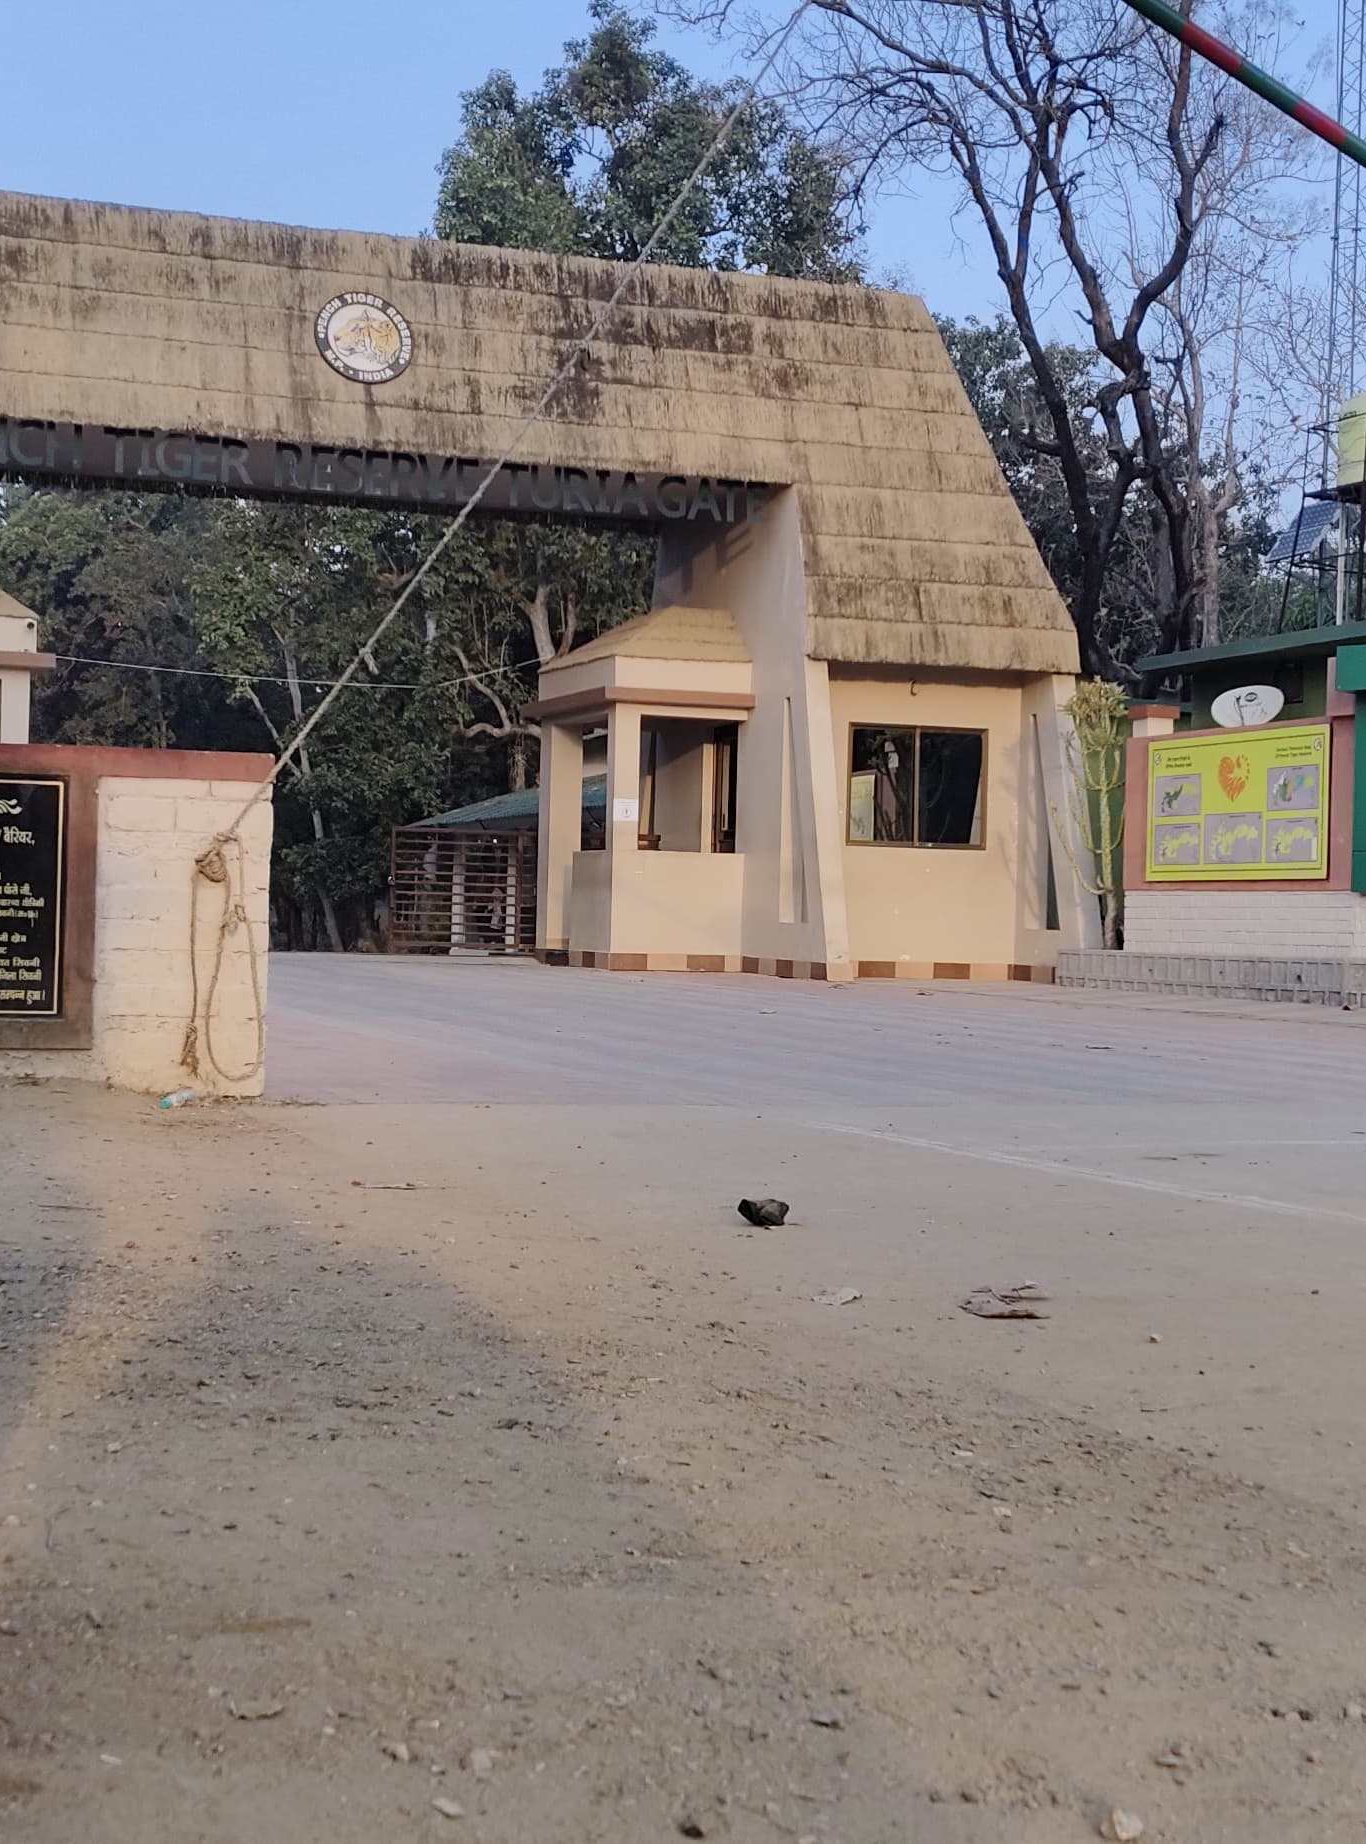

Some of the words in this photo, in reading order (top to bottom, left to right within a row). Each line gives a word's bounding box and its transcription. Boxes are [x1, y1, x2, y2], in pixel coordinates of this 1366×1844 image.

[317, 298, 342, 329] PENCH
[343, 292, 384, 309] TIGER
[386, 306, 412, 361] RESERVE
[358, 368, 395, 381] INDIA
[103, 427, 255, 486] TIGER
[273, 442, 482, 503] RESERVE
[500, 462, 648, 517] TURIA
[654, 477, 770, 524] GATE
